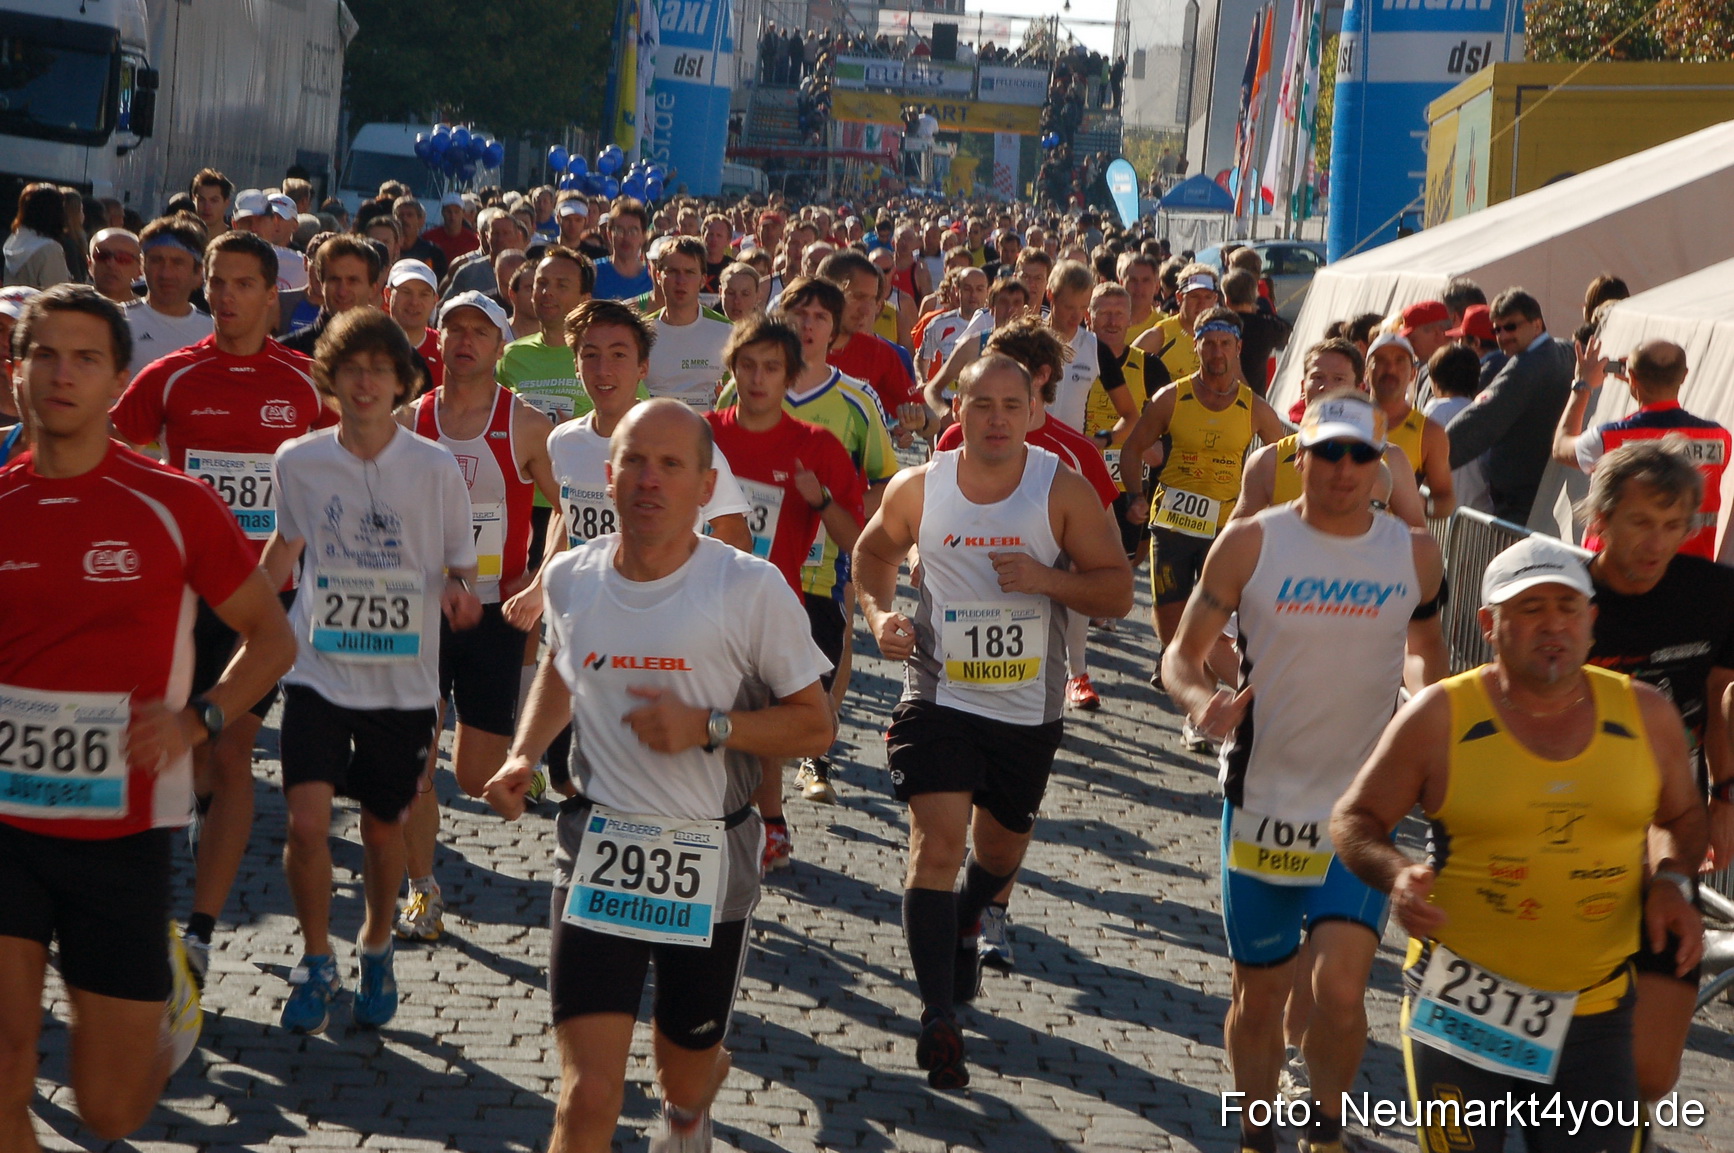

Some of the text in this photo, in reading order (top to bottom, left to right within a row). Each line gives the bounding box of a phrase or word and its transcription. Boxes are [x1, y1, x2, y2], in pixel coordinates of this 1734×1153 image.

[673, 53, 704, 78] dsl
[1447, 40, 1493, 74] dsl
[569, 487, 605, 500] PFLEIDERER
[1172, 492, 1209, 518] 200
[1166, 511, 1207, 531] Michael
[965, 536, 1026, 547] KLEBL
[325, 593, 410, 630] 2753
[957, 609, 1000, 619] PFLEIDERER
[336, 631, 394, 651] Julian
[964, 624, 1024, 659] 183
[611, 656, 693, 672] KLEBL
[963, 660, 1026, 681] Nikolay
[0, 720, 109, 774] 2586
[606, 819, 662, 837] PFLEIDERER
[674, 831, 710, 844] BOCK
[1256, 816, 1321, 847] 764
[589, 840, 702, 900] 2935
[1257, 850, 1310, 872] Peter
[588, 890, 692, 928] Berthold
